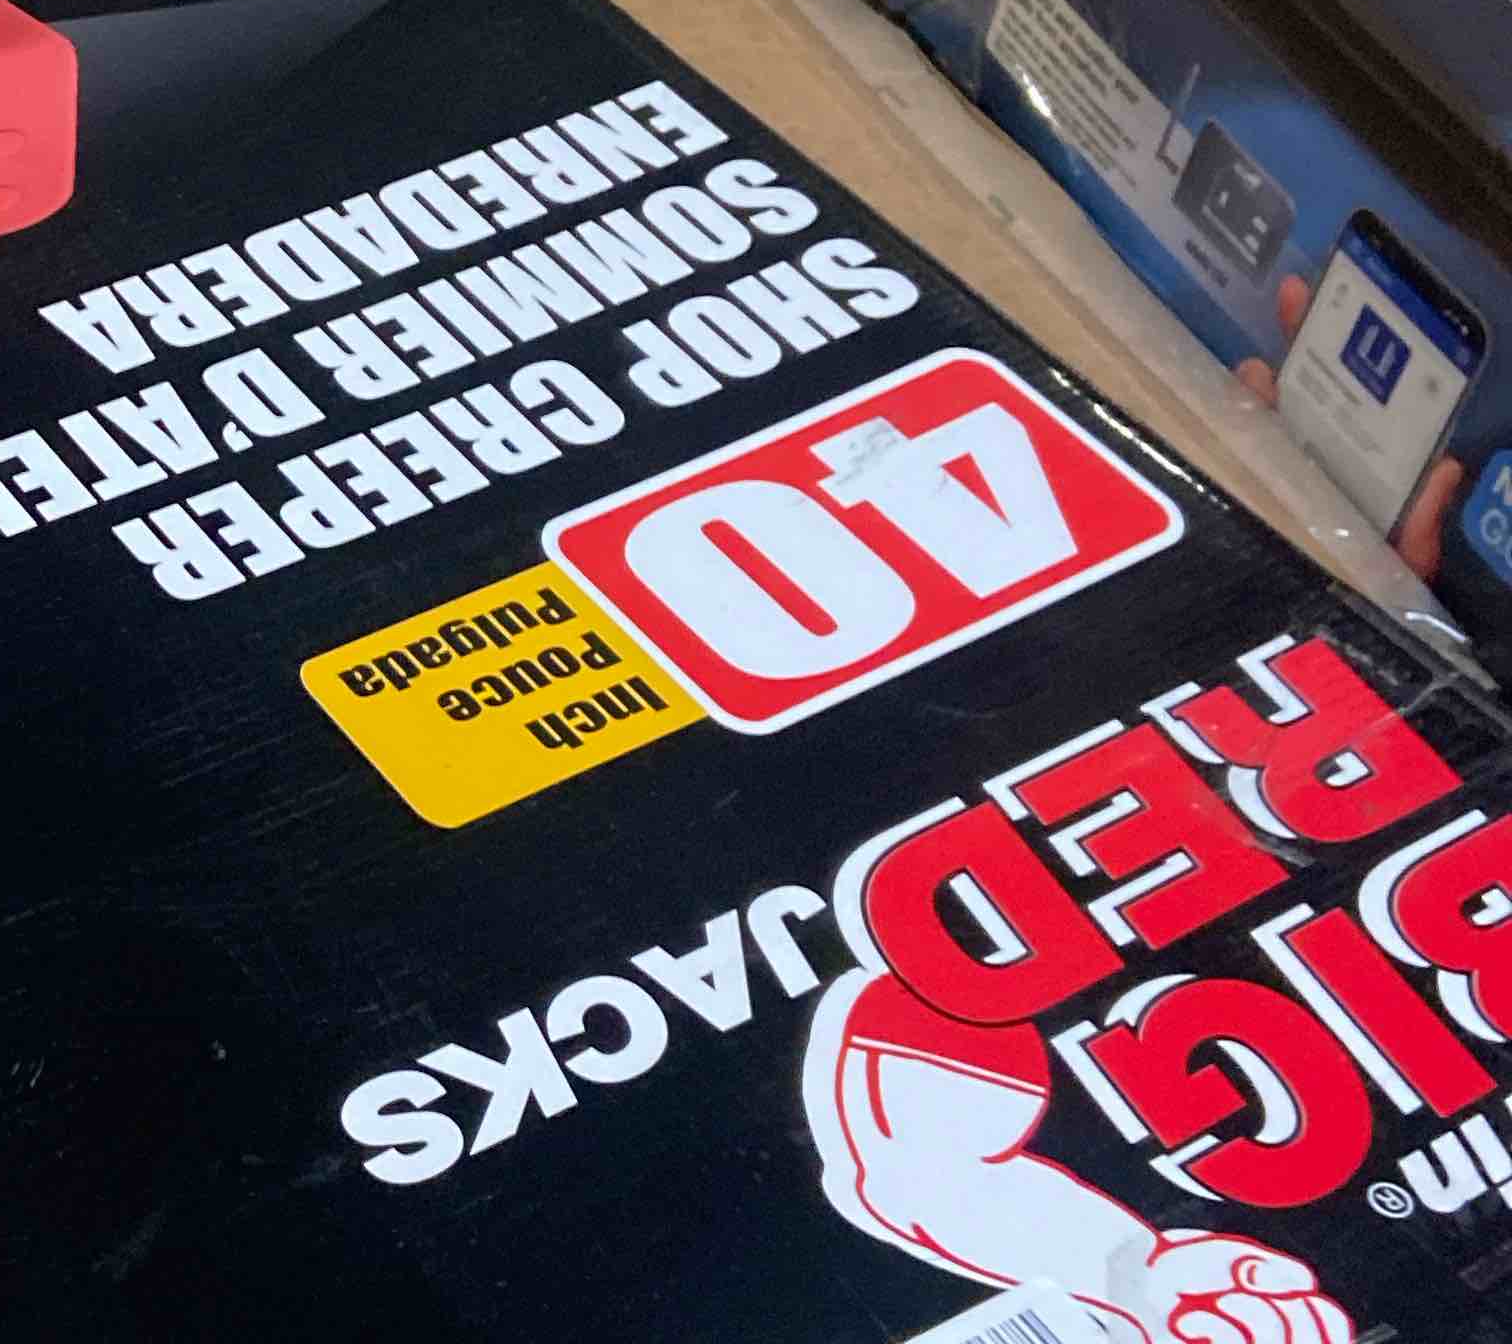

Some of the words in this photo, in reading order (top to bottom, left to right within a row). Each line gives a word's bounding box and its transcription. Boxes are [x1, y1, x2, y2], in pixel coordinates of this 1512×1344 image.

[38, 79, 730, 374] ENREDADERA
[293, 158, 819, 400] SOMMIER
[624, 236, 921, 408] SHOP
[111, 360, 625, 601] CREEPER
[625, 402, 1078, 679] 40
[338, 587, 579, 699] Pulgada
[437, 631, 622, 721] Pouce
[525, 676, 669, 752] Inch
[833, 633, 1463, 1027] RED
[340, 884, 826, 1185] JACKS
